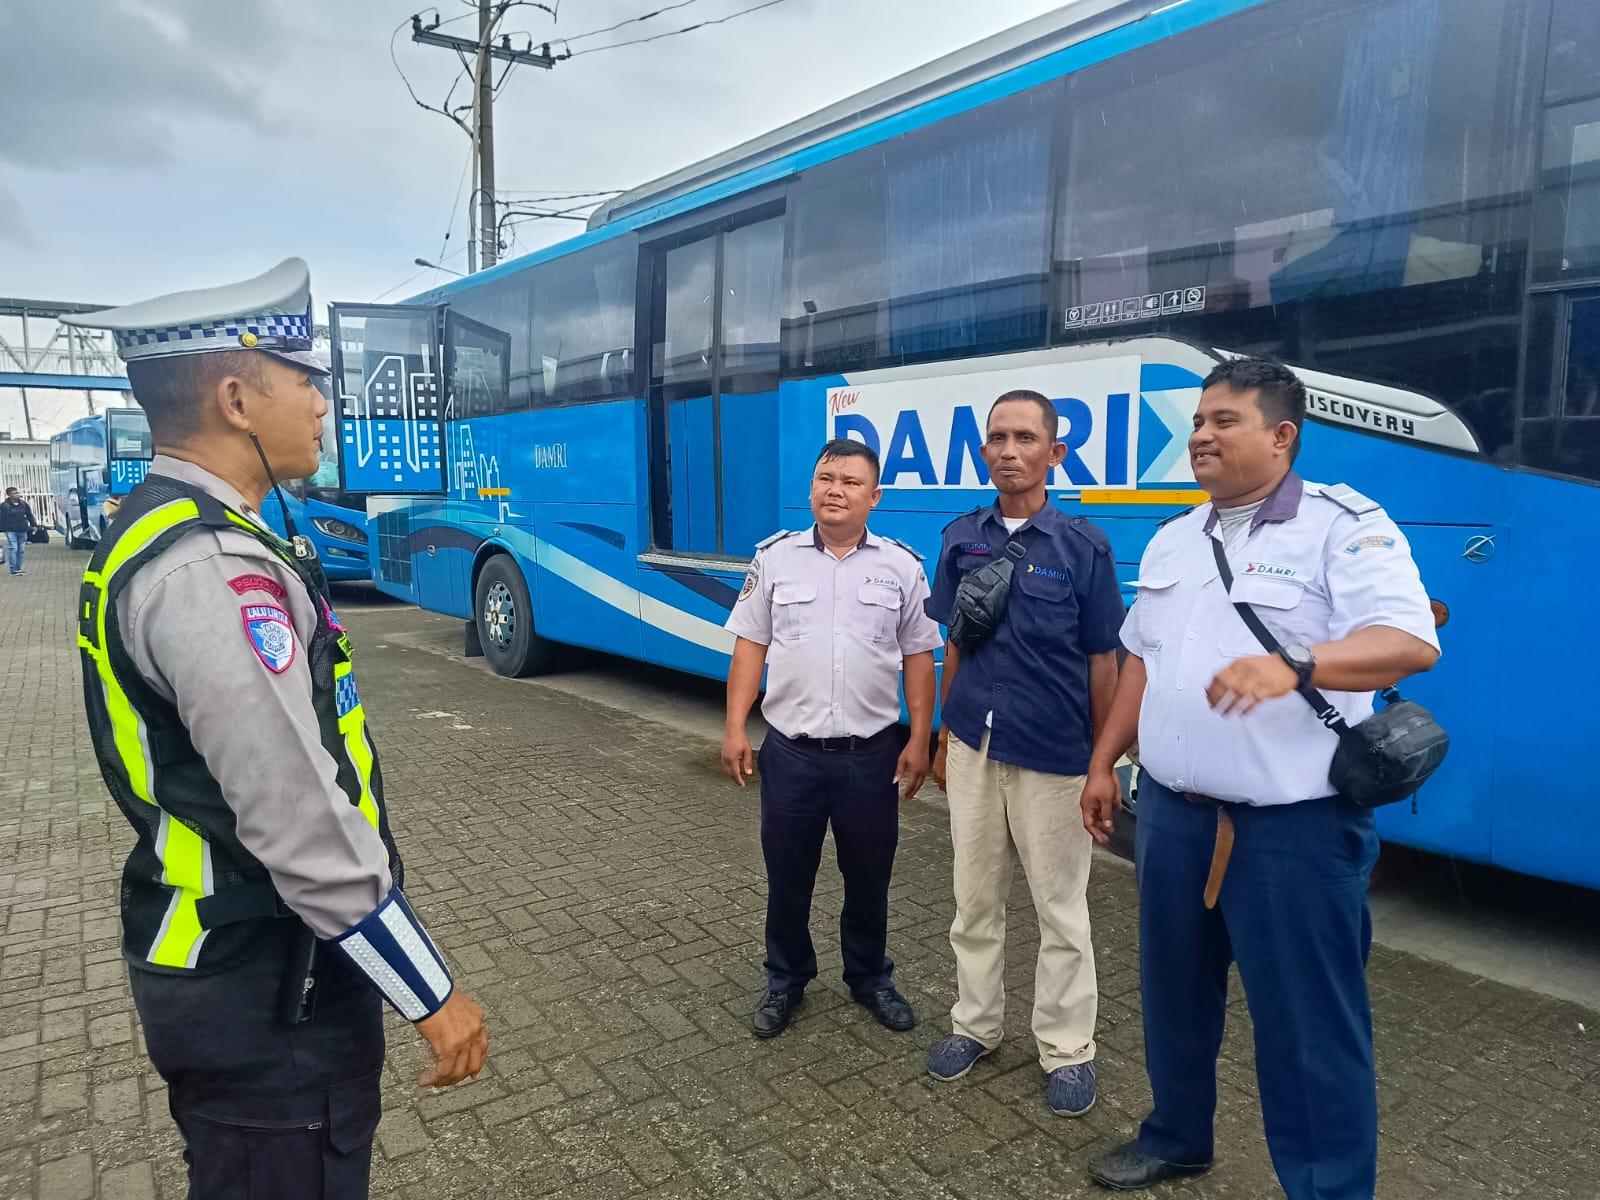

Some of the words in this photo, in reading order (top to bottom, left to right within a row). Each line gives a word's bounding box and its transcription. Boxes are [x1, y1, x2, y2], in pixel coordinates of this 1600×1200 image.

[829, 390, 861, 415] New
[1305, 394, 1415, 436] ISCOVERY
[535, 443, 568, 468] DAMRI
[1035, 565, 1065, 581] DAMRI
[1257, 565, 1297, 577] DAMRI
[874, 577, 898, 587] DAMRI
